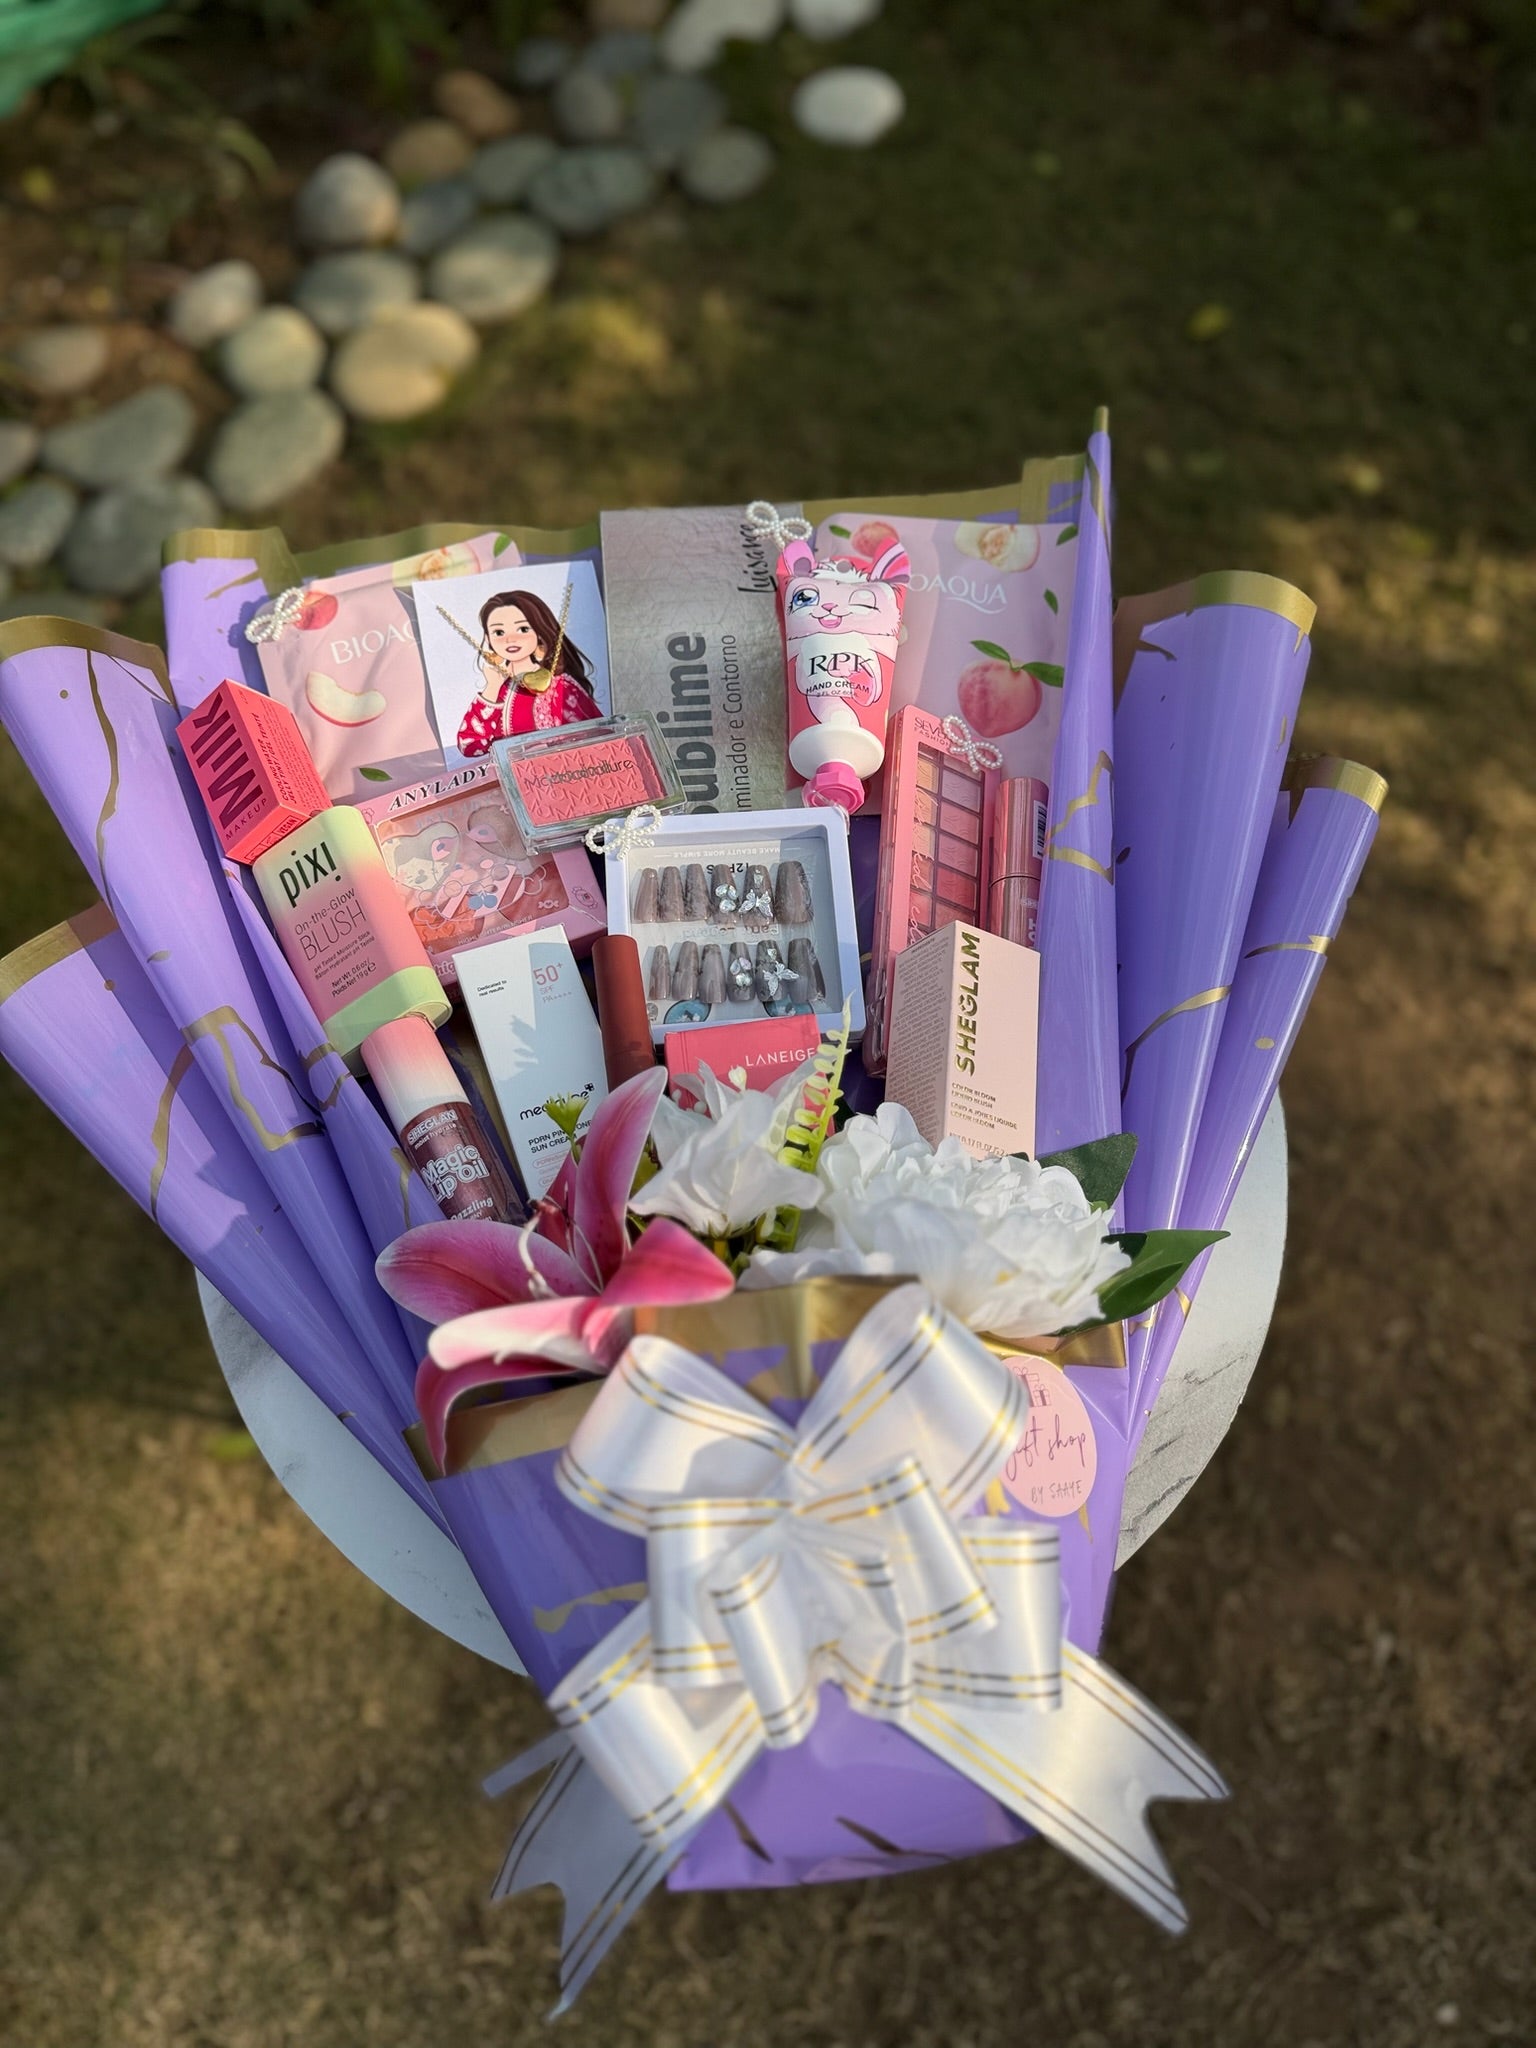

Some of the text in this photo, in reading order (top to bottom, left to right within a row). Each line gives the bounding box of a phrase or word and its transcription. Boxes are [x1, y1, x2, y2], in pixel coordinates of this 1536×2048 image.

[906, 573, 1008, 614] OAQUA
[805, 681, 833, 695] HAND
[834, 680, 870, 694] CREAM
[807, 652, 875, 678] RPK
[657, 633, 720, 814] ublime
[721, 634, 753, 812] minador e Contorno
[389, 763, 490, 811] ANYLADY
[224, 797, 268, 841] MAKEUP
[294, 887, 356, 936] On-the-Glow
[299, 898, 367, 961] BLUSH
[954, 931, 981, 1077] SHEGLAM
[421, 1143, 481, 1186] Magic
[530, 1142, 548, 1154] SUN
[430, 1158, 490, 1203] Lip Oil
[1047, 1413, 1086, 1468] shop
[1031, 1485, 1044, 1503] BY
